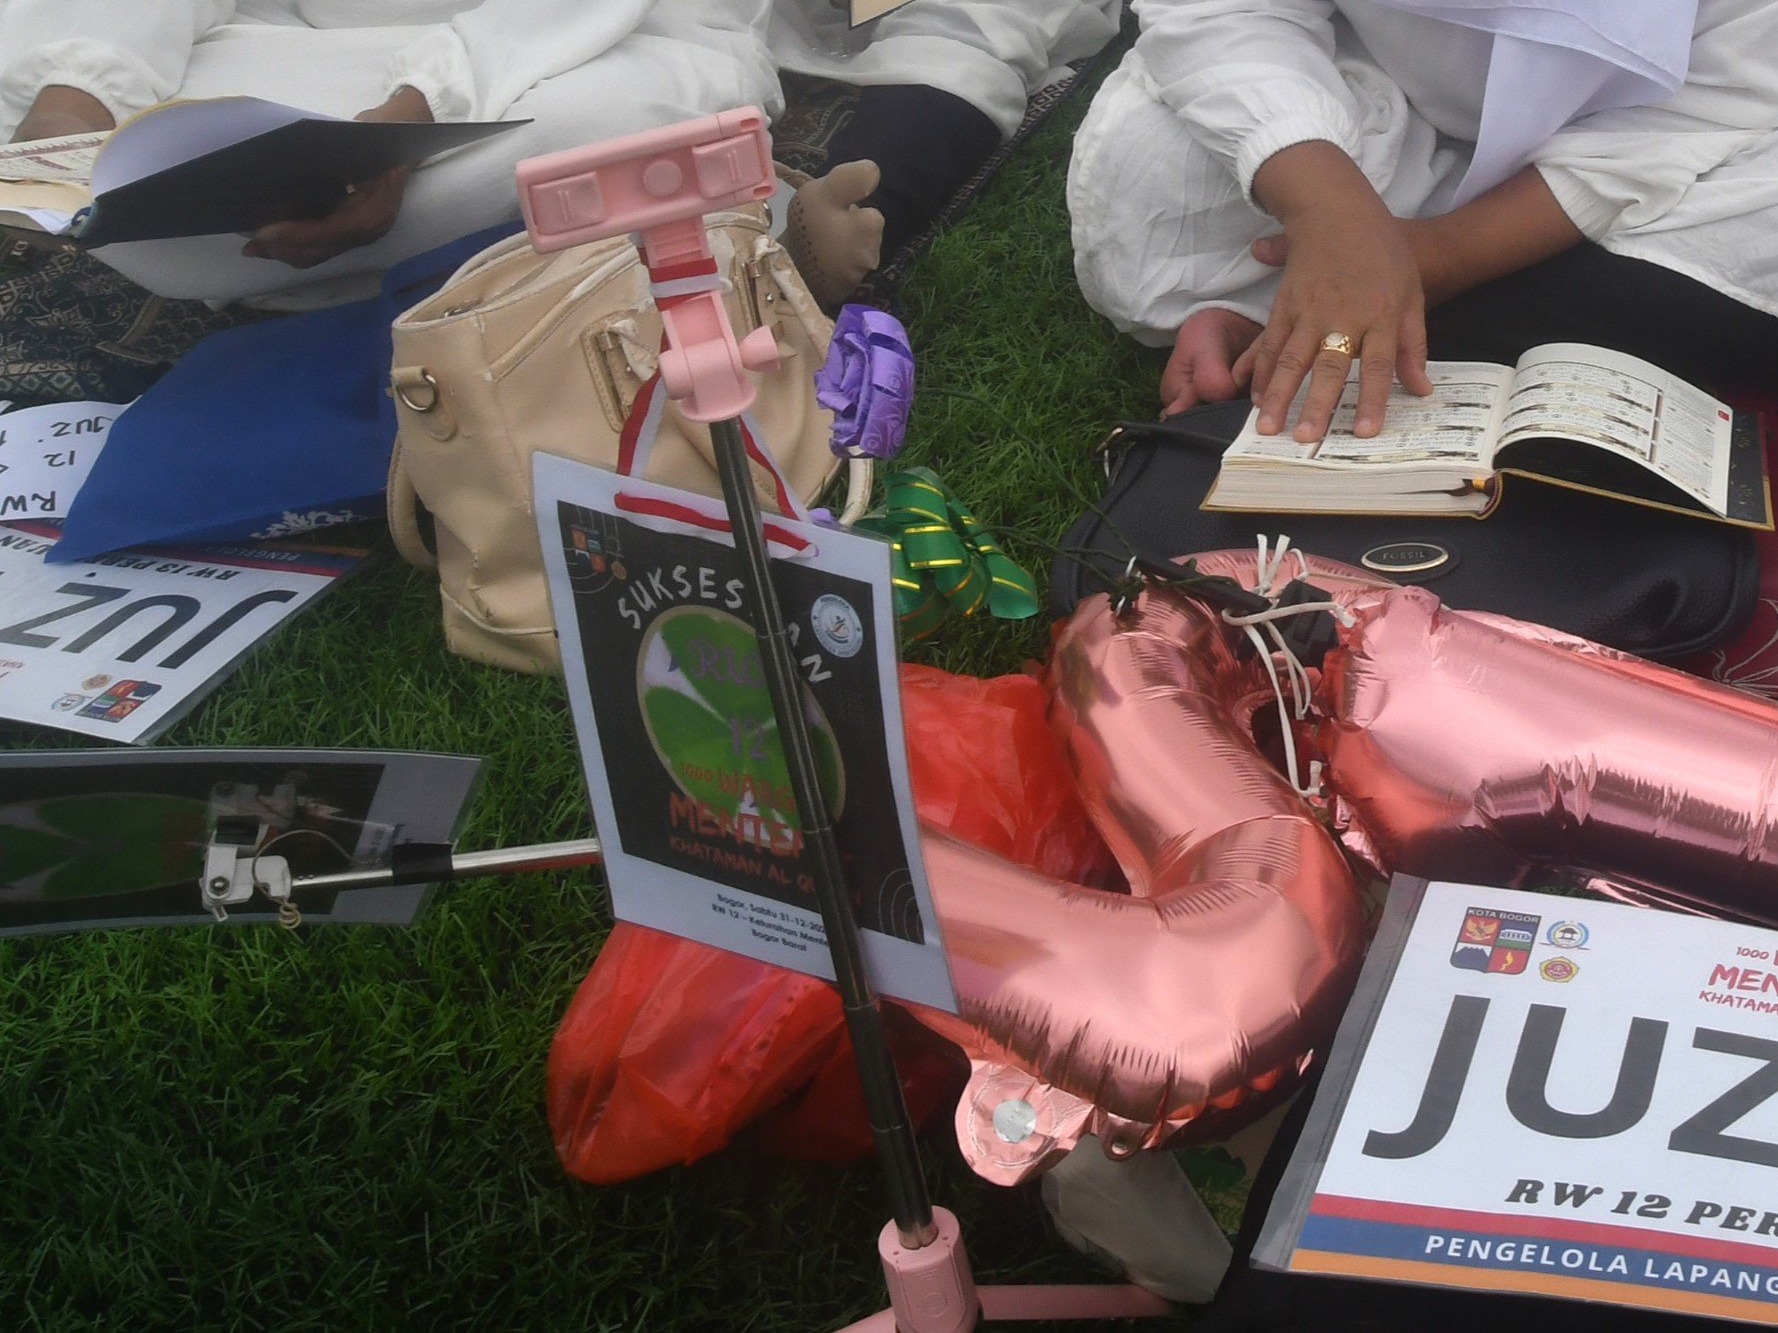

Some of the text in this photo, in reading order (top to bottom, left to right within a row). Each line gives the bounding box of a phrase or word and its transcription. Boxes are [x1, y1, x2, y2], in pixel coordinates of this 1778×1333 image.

[51, 415, 113, 438] JUZ
[43, 450, 76, 468] 12
[0, 490, 56, 515] RW
[0, 582, 299, 669] JUZ
[718, 768, 797, 812] WARG
[669, 791, 804, 859] MENTE
[780, 913, 826, 934] 31-12-202
[1468, 909, 1540, 924] KOTA BOGOR
[800, 930, 829, 947] Mente
[1736, 946, 1769, 960] 1000
[1504, 1178, 1606, 1212] RW
[1609, 1189, 1673, 1220] 12
[1423, 1233, 1630, 1275] PENGELOLA
